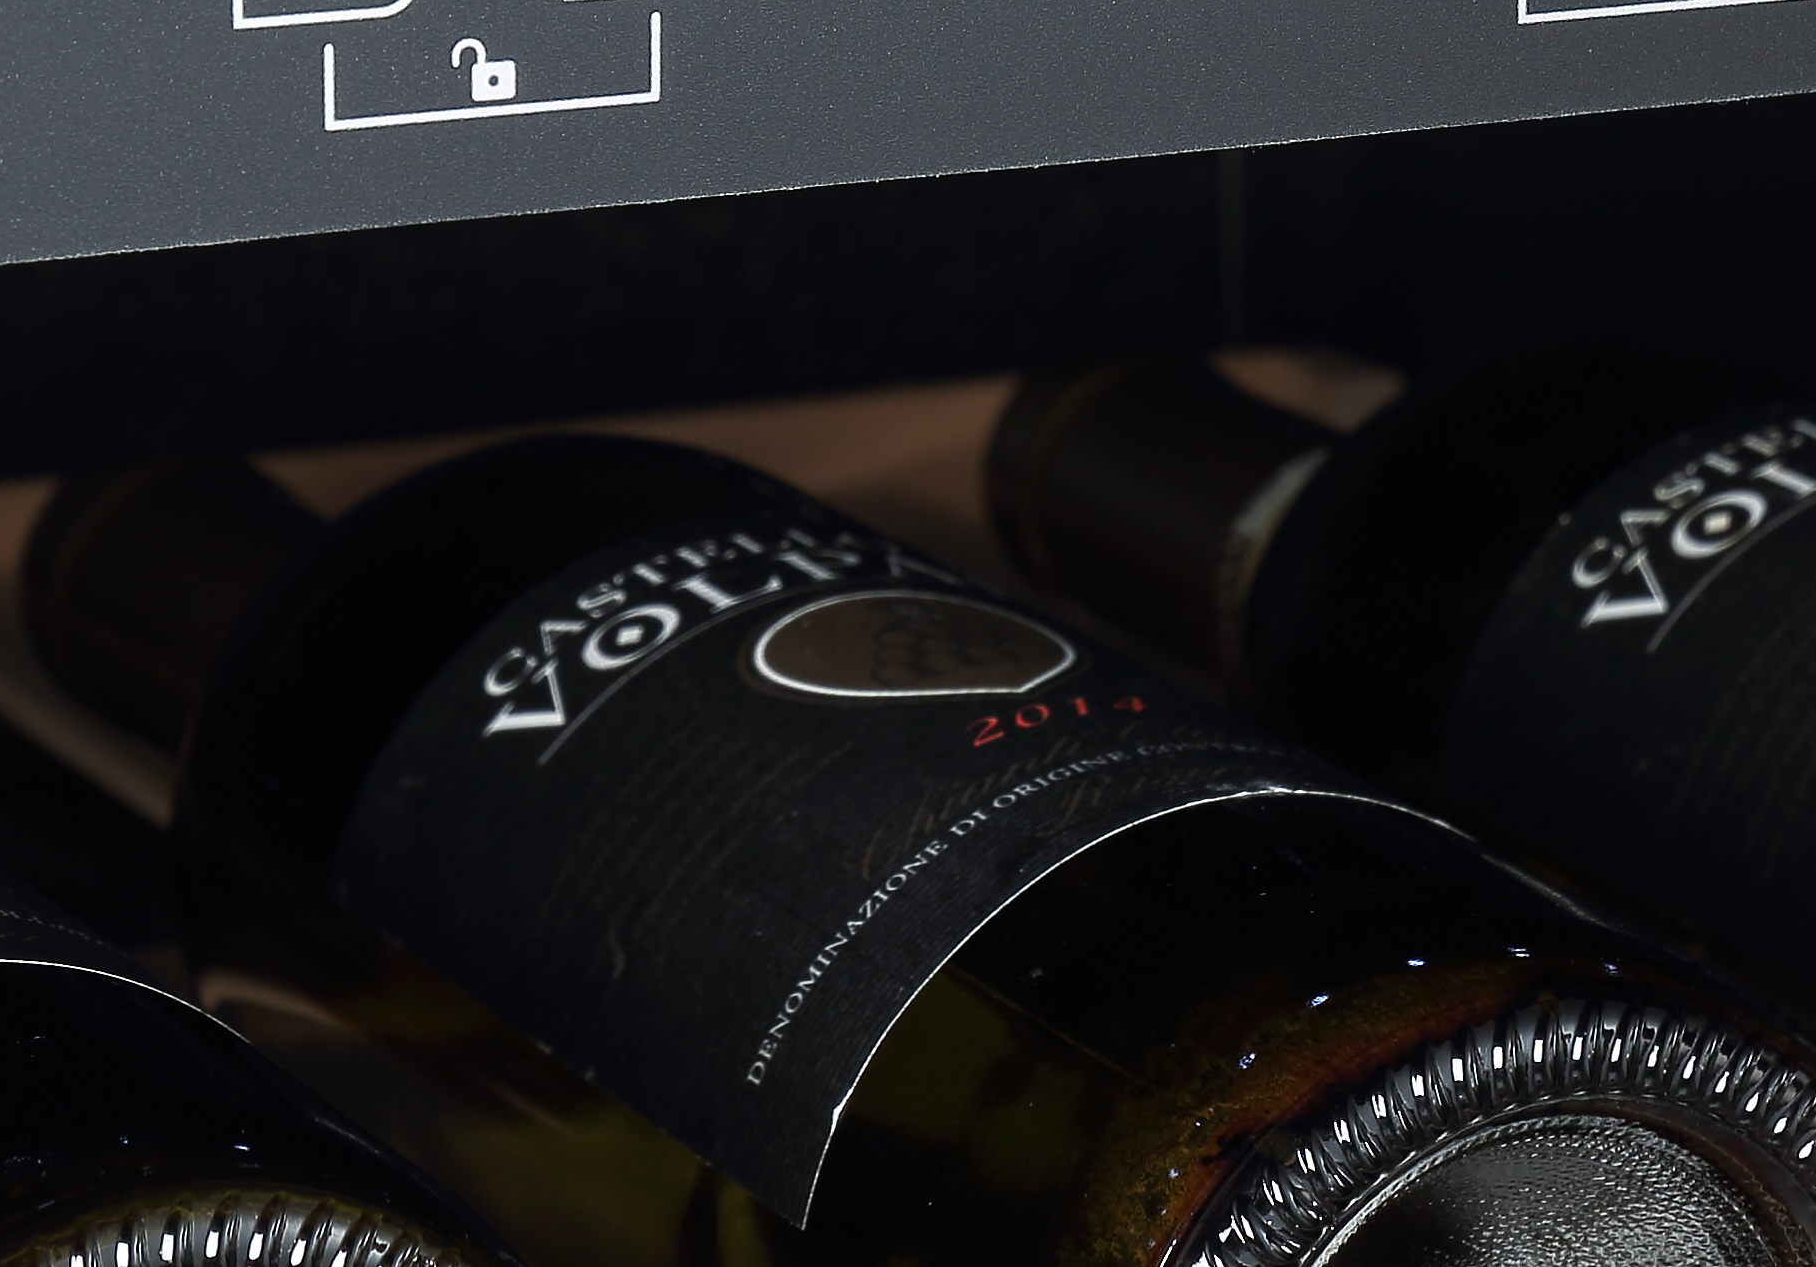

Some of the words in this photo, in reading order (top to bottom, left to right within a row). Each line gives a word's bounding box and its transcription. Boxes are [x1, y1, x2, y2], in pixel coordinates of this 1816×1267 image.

[965, 695, 1149, 749] 2014
[746, 839, 950, 1086] DENOMINAZIONE
[949, 809, 990, 838] DI
[993, 750, 1132, 809] ORIGINE
